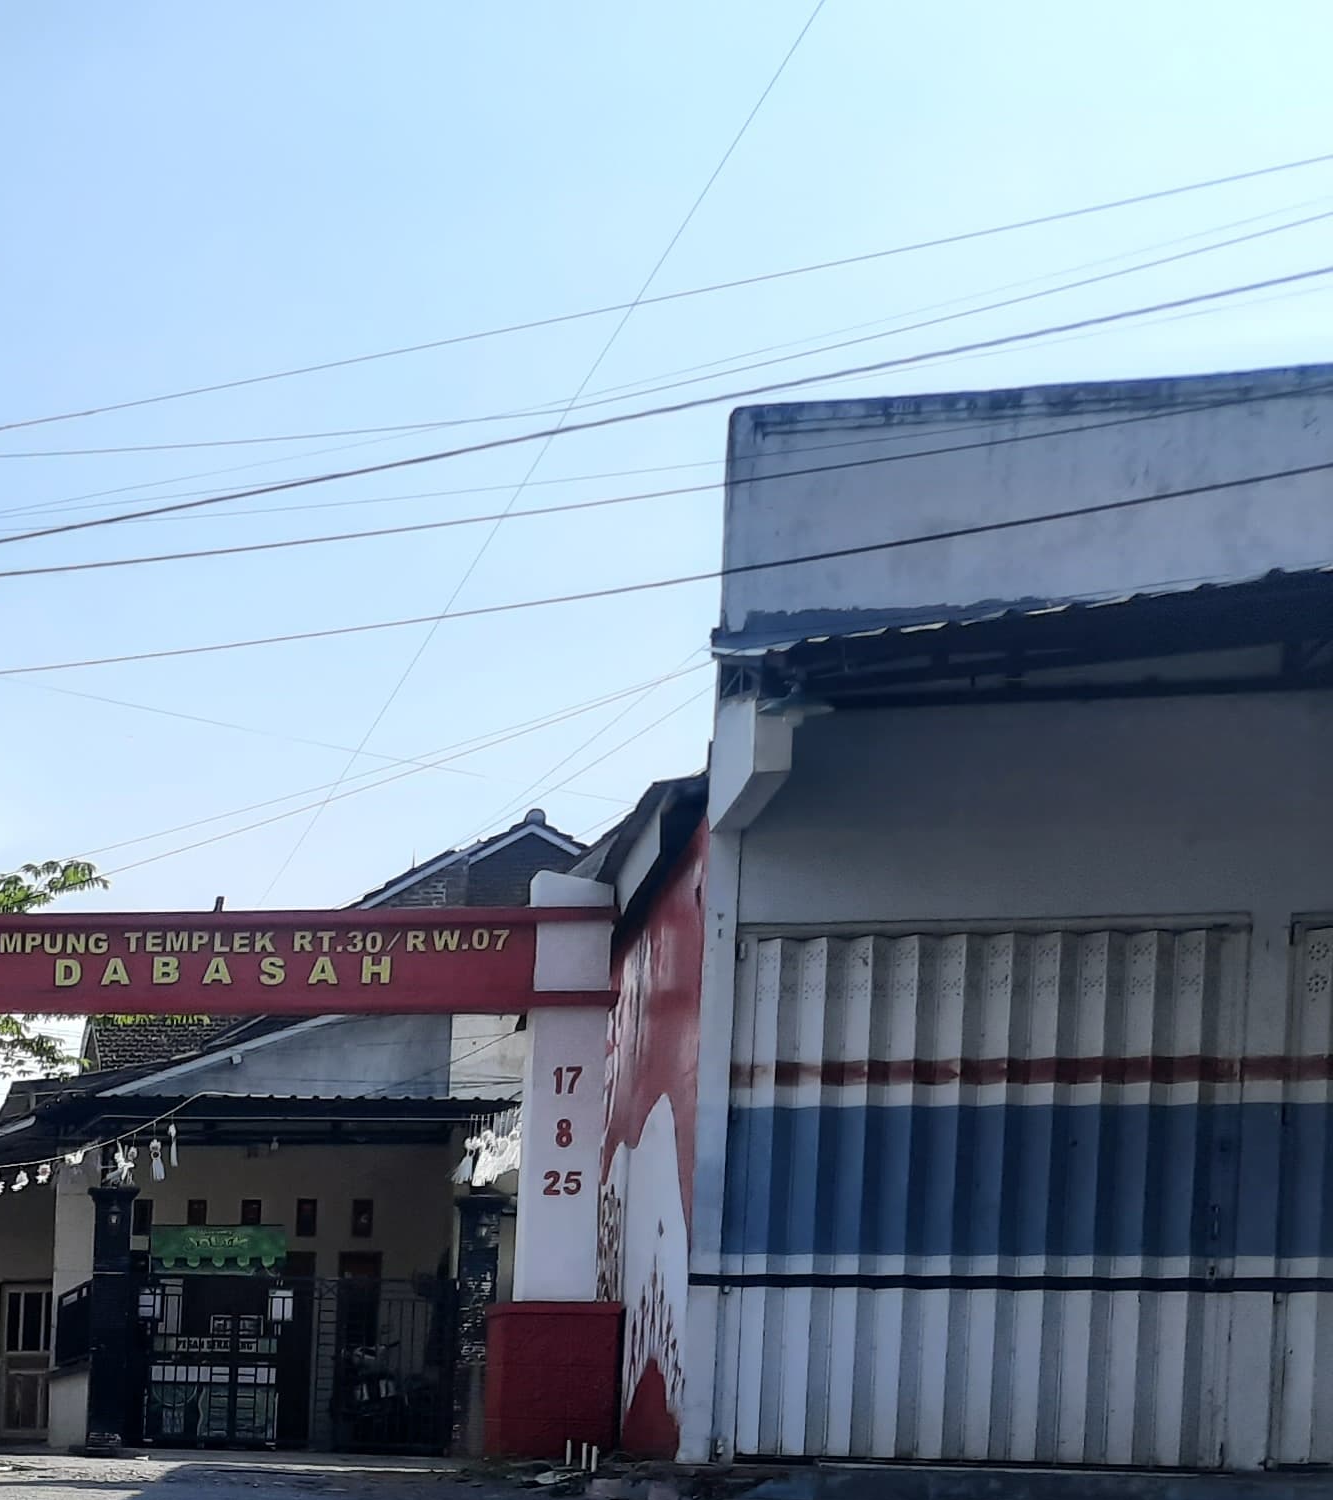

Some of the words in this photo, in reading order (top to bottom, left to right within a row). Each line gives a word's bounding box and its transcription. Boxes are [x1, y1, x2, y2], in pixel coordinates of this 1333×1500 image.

[124, 930, 276, 953] TEMPLEK
[54, 955, 392, 987] DABASAH
[552, 1065, 584, 1095] 17
[555, 1118, 573, 1148] 8
[542, 1170, 583, 1196] 25
